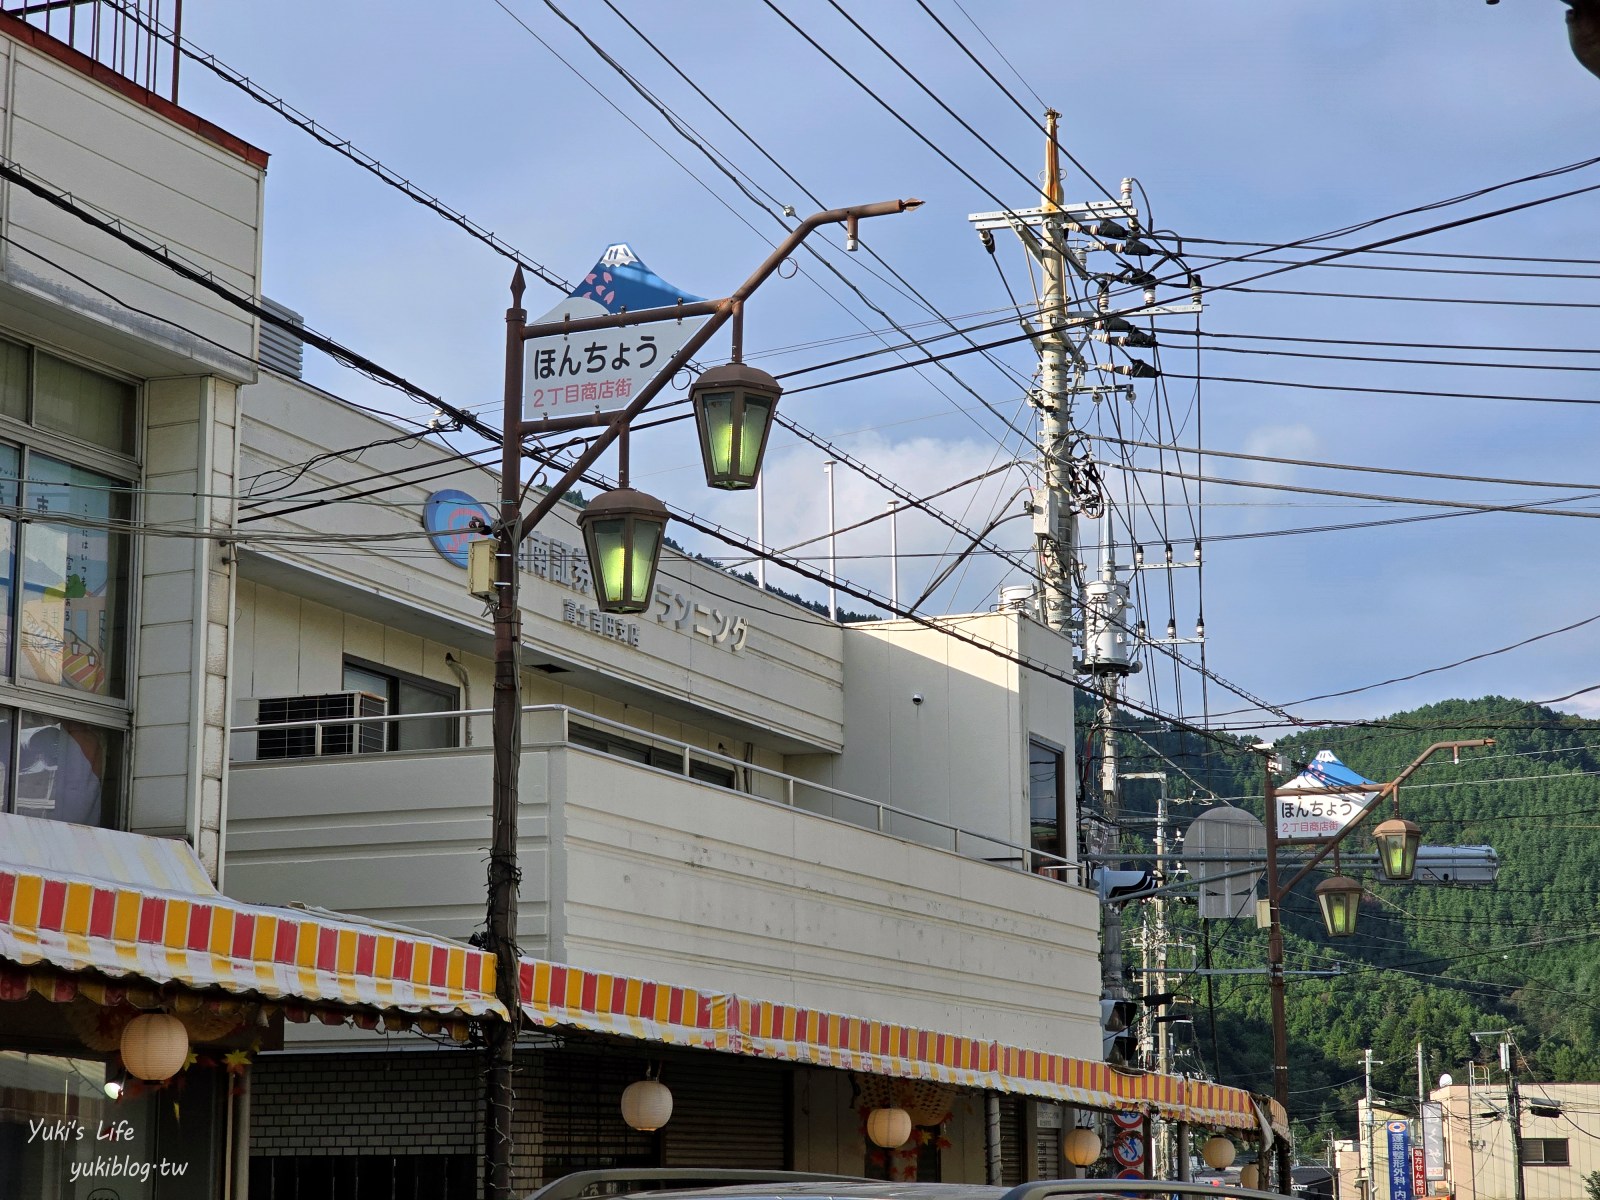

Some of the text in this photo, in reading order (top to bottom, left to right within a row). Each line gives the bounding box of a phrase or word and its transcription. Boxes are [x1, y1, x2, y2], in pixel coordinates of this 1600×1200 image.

[534, 335, 658, 380] ほんちょう
[533, 377, 632, 408] 2丁目商店街
[563, 598, 640, 648] 富士吉田支店
[1281, 799, 1353, 818] ほんちょう
[1282, 820, 1339, 832] 2丁目商店街
[1414, 1149, 1424, 1194] 処方せん受付
